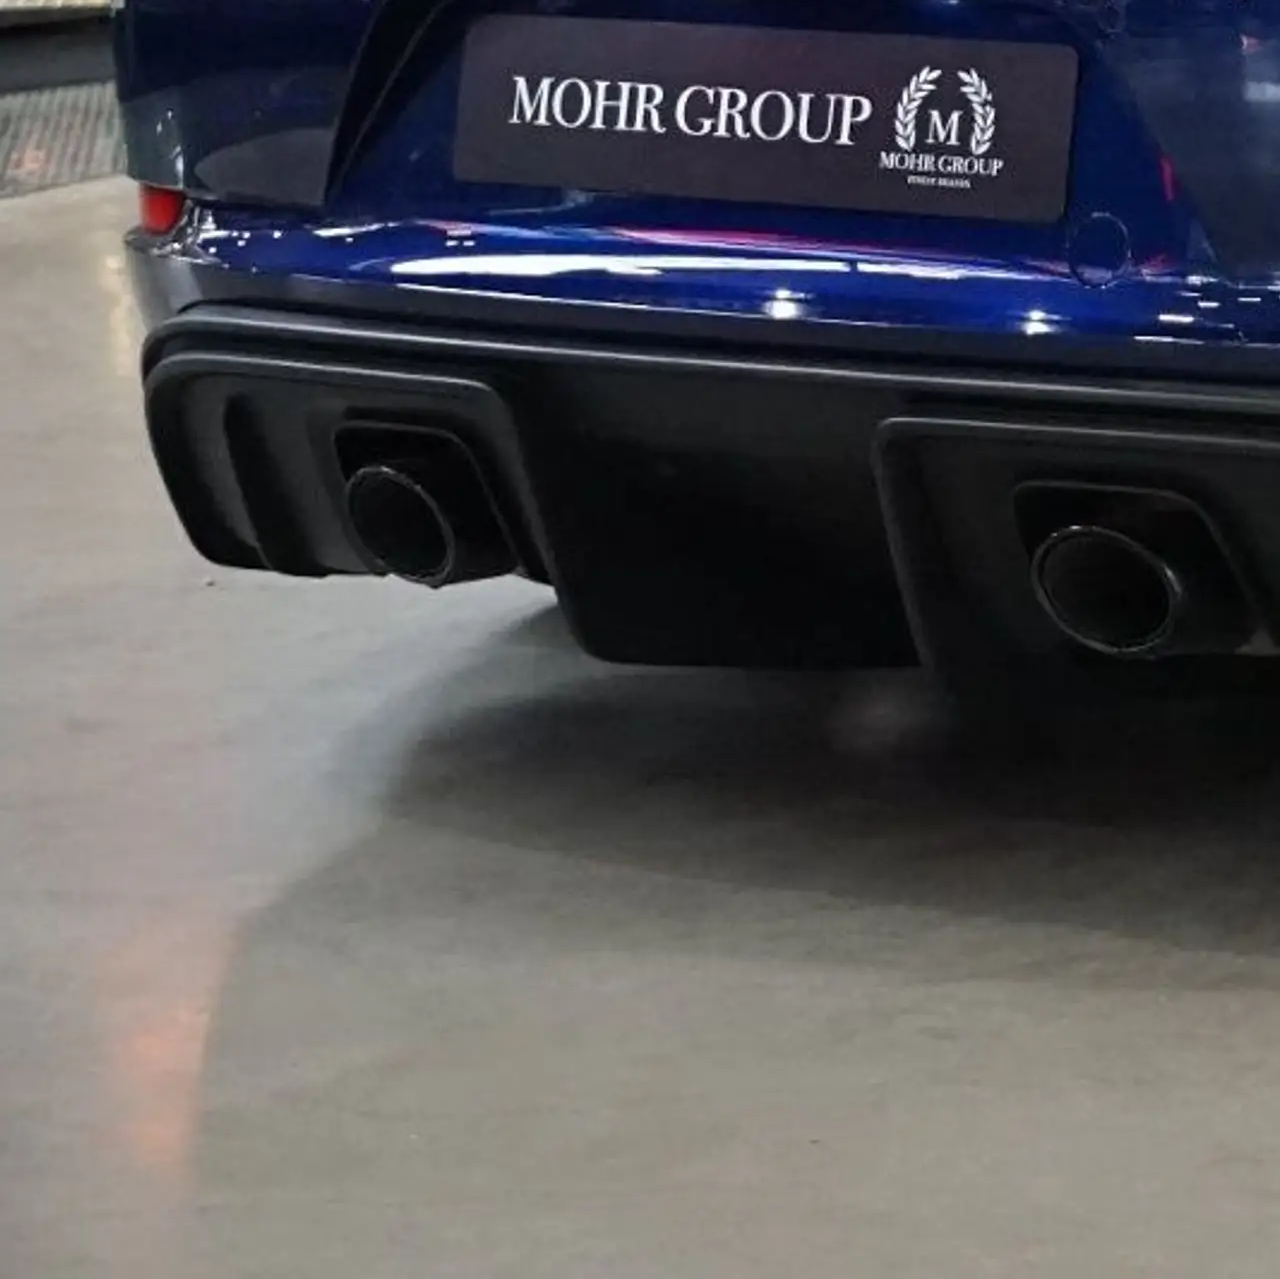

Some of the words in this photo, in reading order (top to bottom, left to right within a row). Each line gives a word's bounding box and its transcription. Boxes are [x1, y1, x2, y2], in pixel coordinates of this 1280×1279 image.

[508, 75, 667, 134] MOHR
[675, 84, 873, 146] GROUP
[925, 109, 963, 146] M
[879, 150, 937, 172] MOHR
[938, 154, 1004, 176] GROUP
